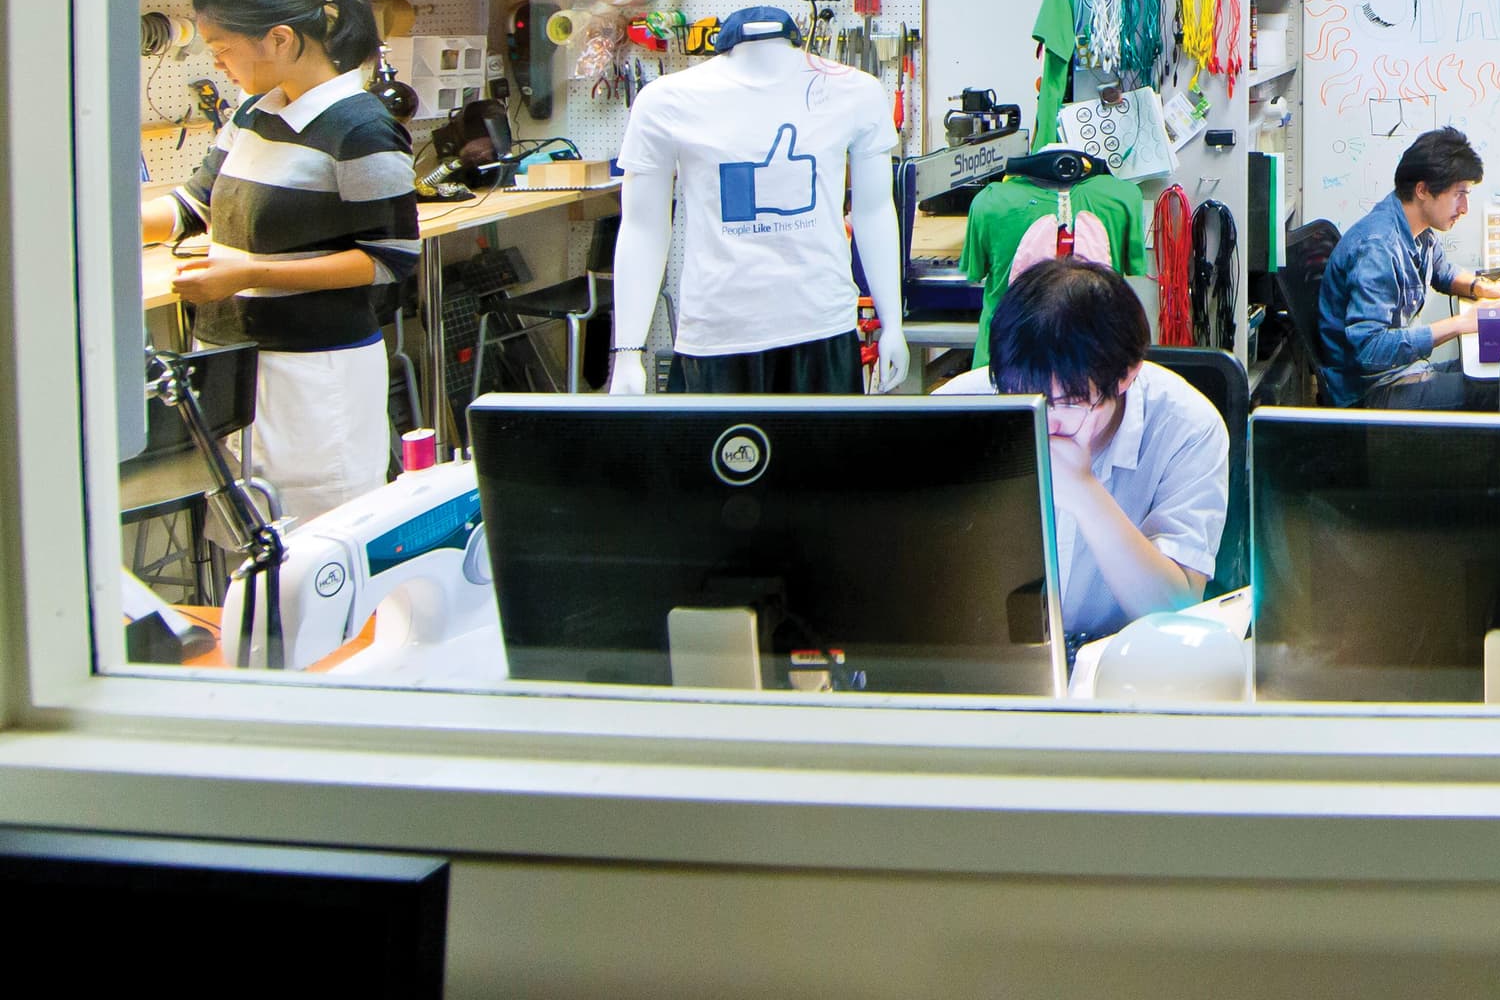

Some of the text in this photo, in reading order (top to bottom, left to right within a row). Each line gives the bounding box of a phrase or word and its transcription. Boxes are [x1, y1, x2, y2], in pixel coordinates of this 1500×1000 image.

[950, 147, 1004, 176] ShopBot
[721, 218, 817, 237] People Like This Shirt!
